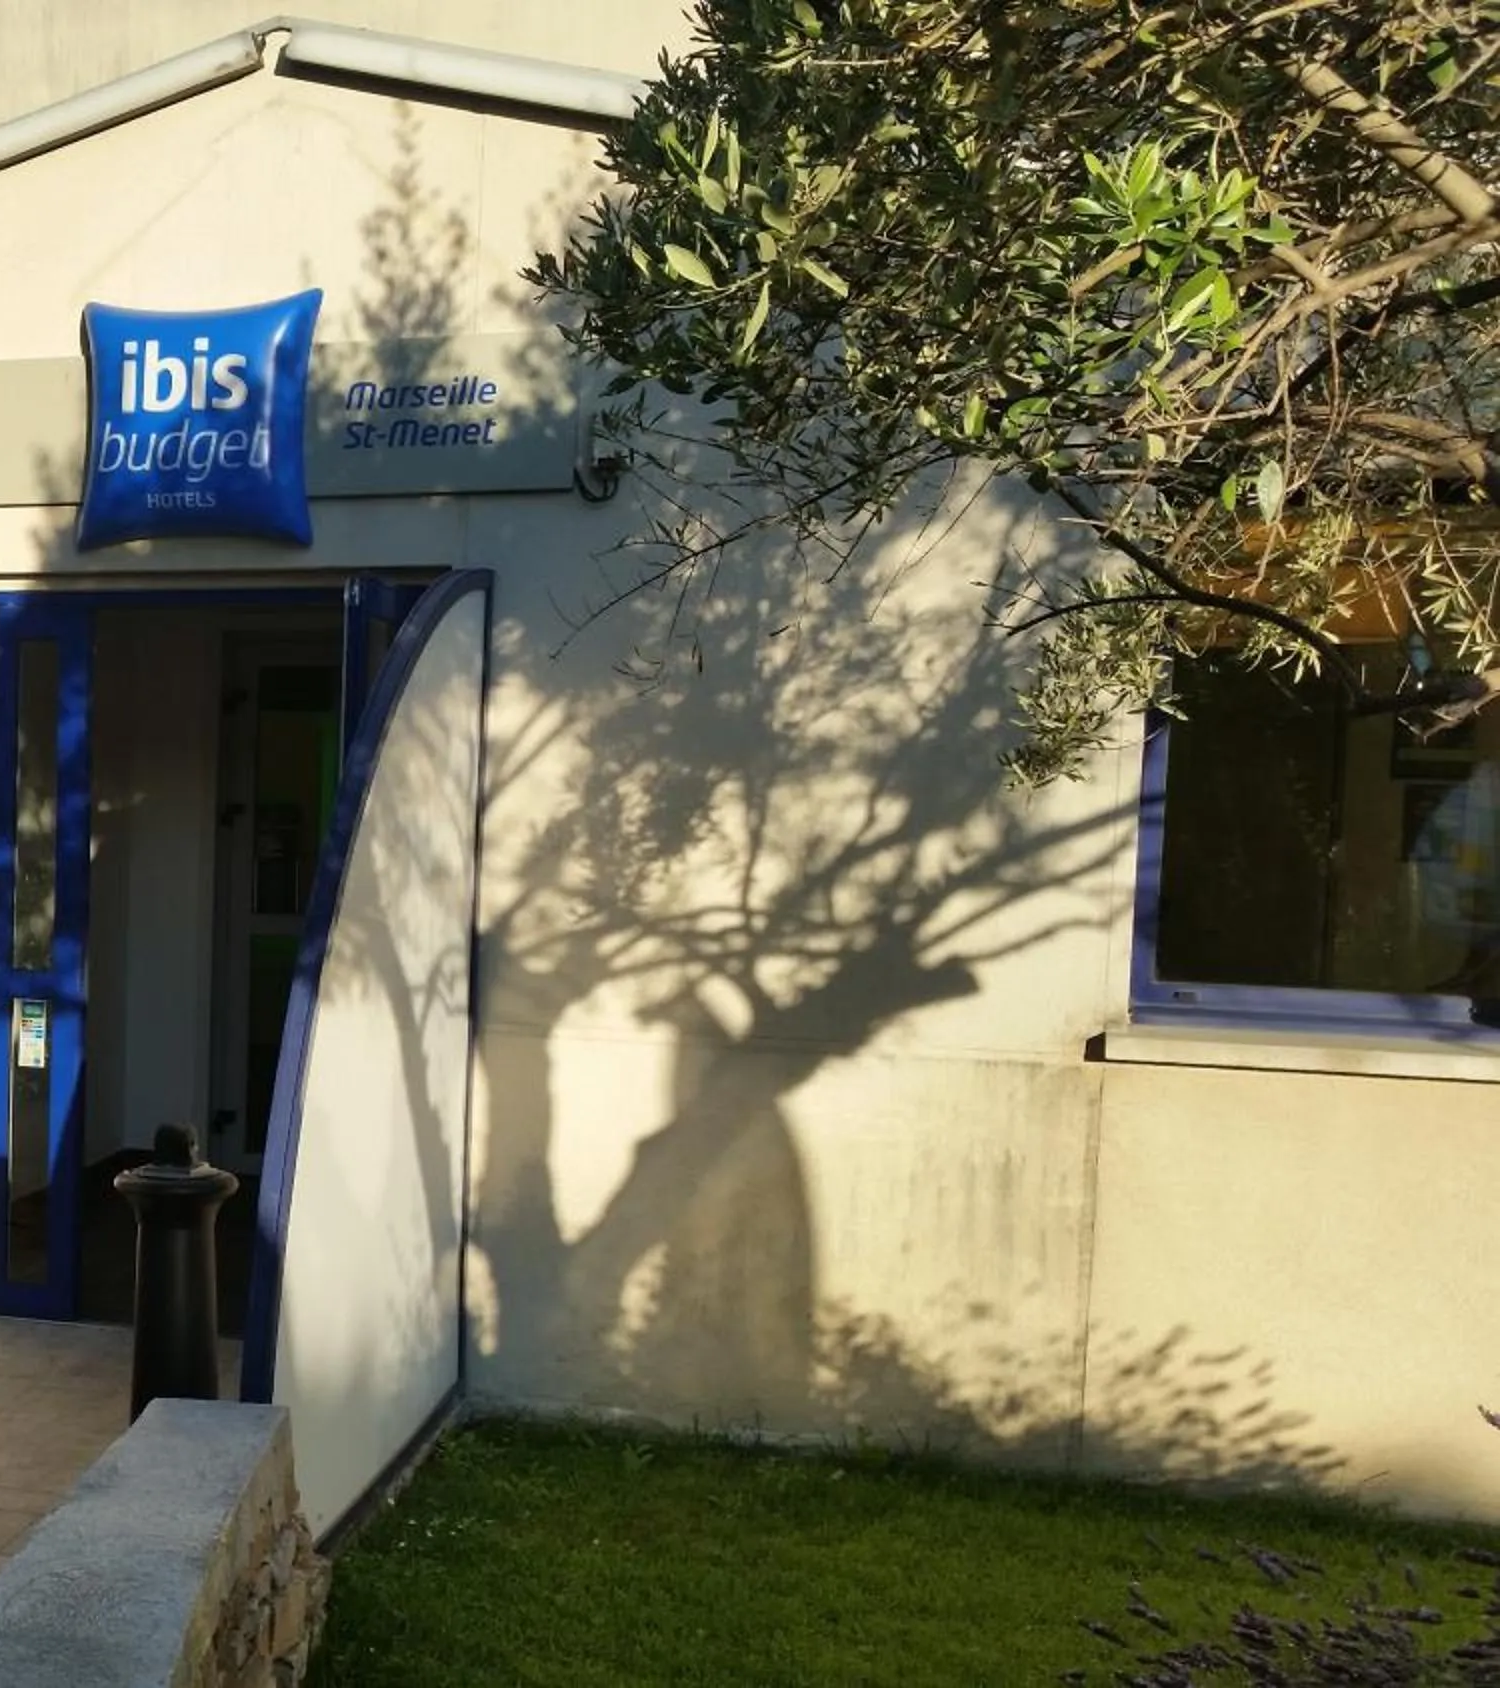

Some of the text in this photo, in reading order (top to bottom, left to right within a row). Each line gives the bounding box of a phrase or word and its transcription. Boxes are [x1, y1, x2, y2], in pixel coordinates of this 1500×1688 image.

[121, 338, 248, 412] ibis
[345, 375, 497, 410] Marseille
[99, 420, 269, 482] budget
[343, 418, 497, 449] St-Menet
[146, 491, 216, 509] HOTELS
